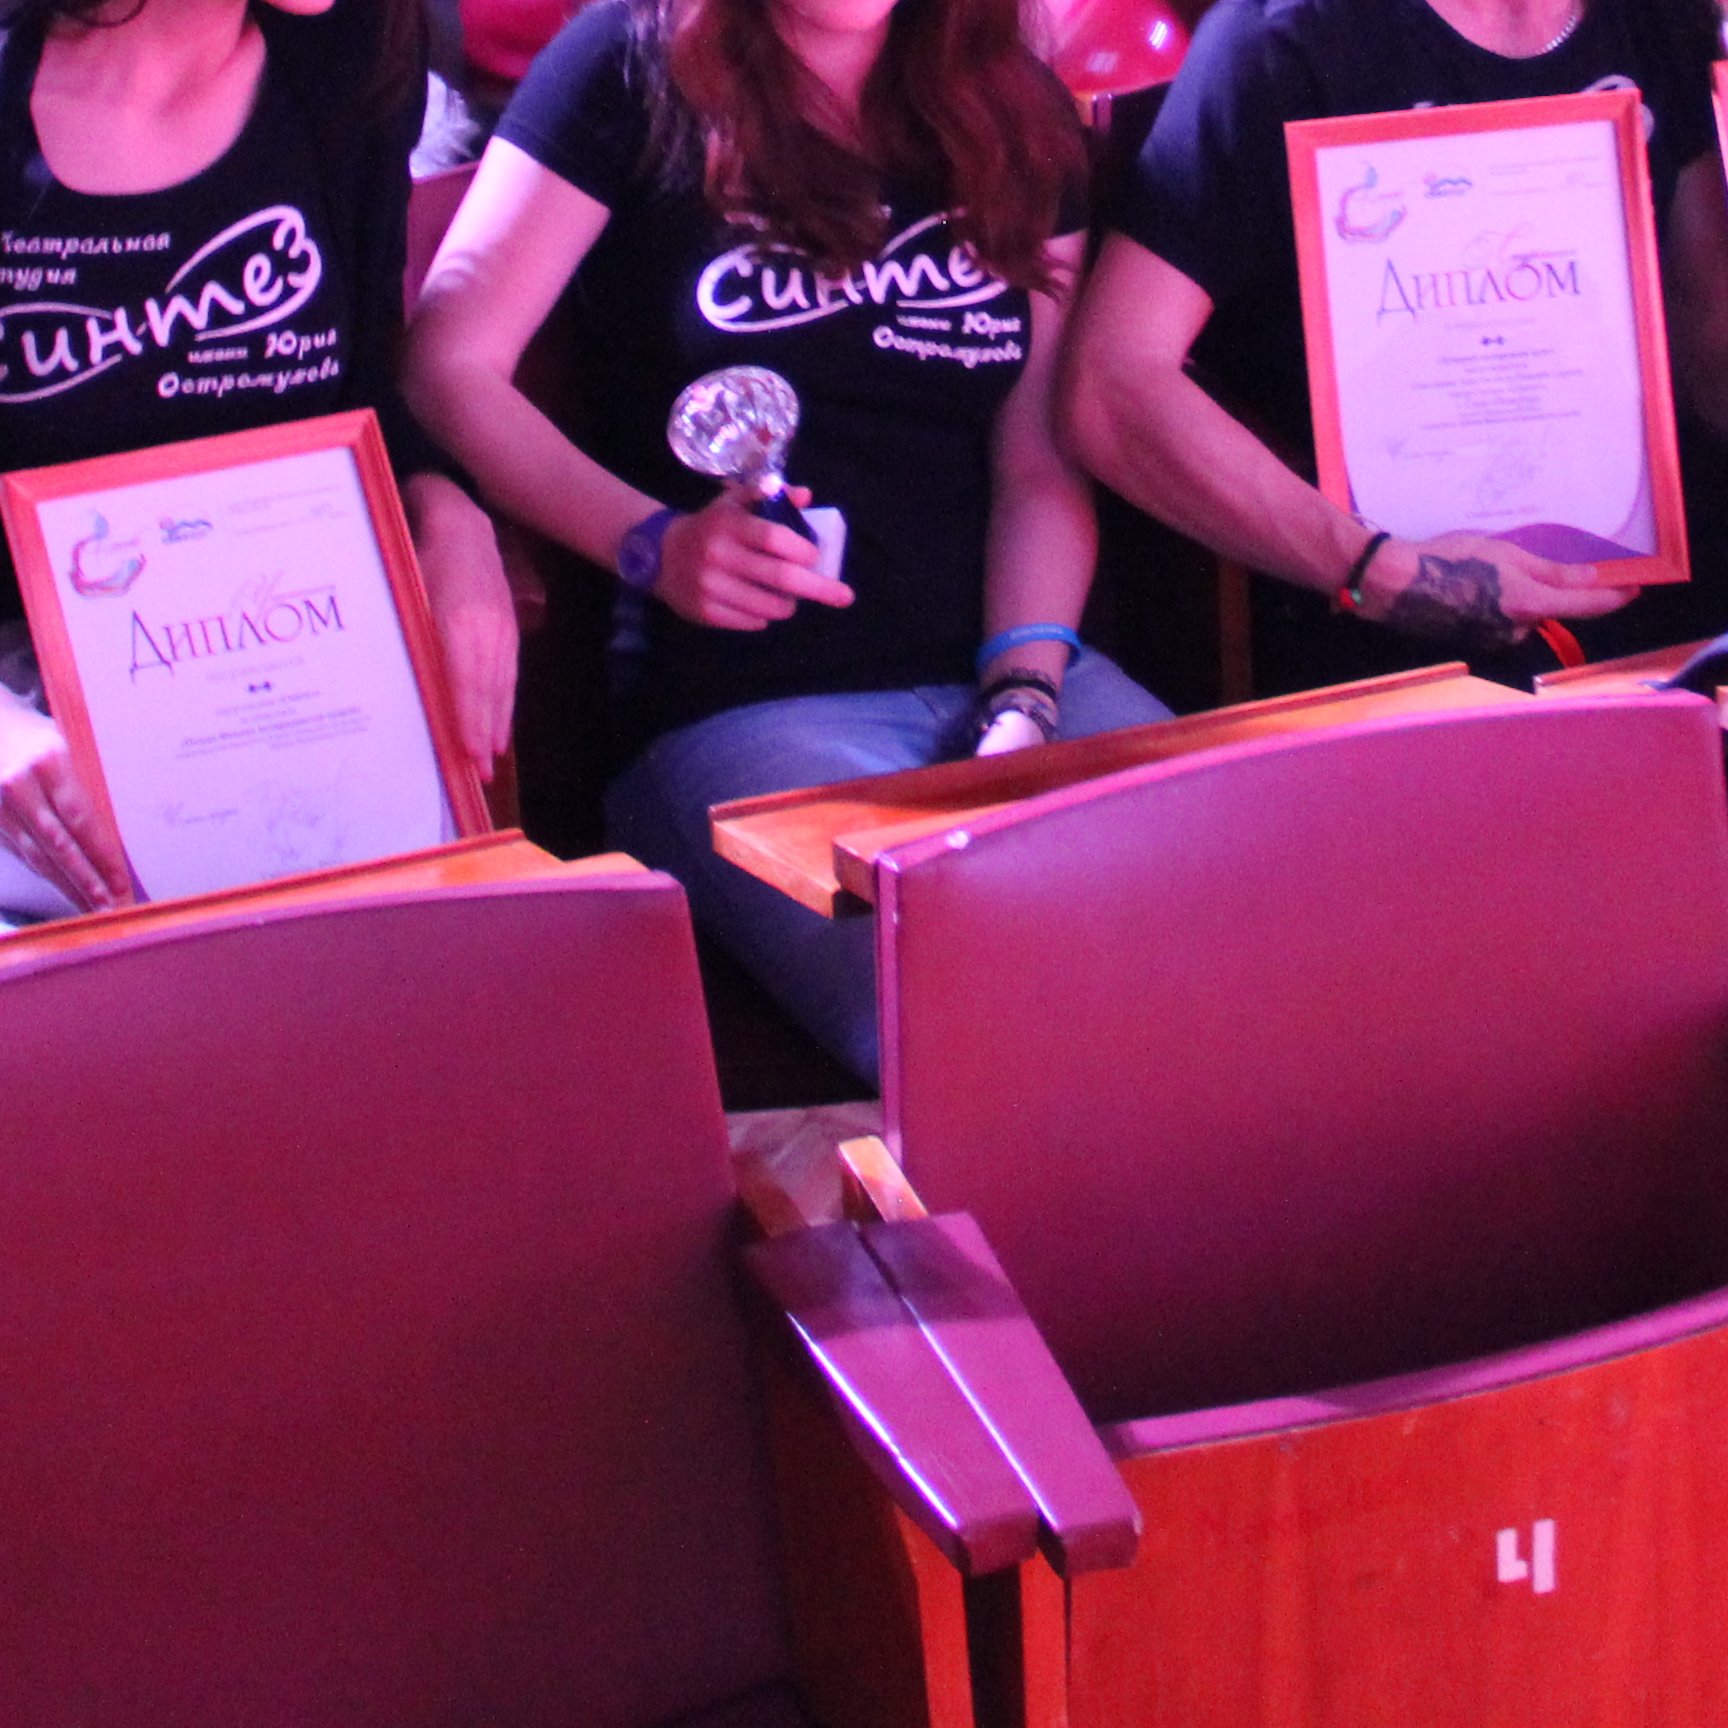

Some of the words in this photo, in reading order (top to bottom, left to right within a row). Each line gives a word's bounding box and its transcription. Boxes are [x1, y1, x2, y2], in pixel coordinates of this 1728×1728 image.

[1, 230, 170, 260] Театральная
[696, 234, 997, 331] Синте
[264, 328, 338, 361] Юрия
